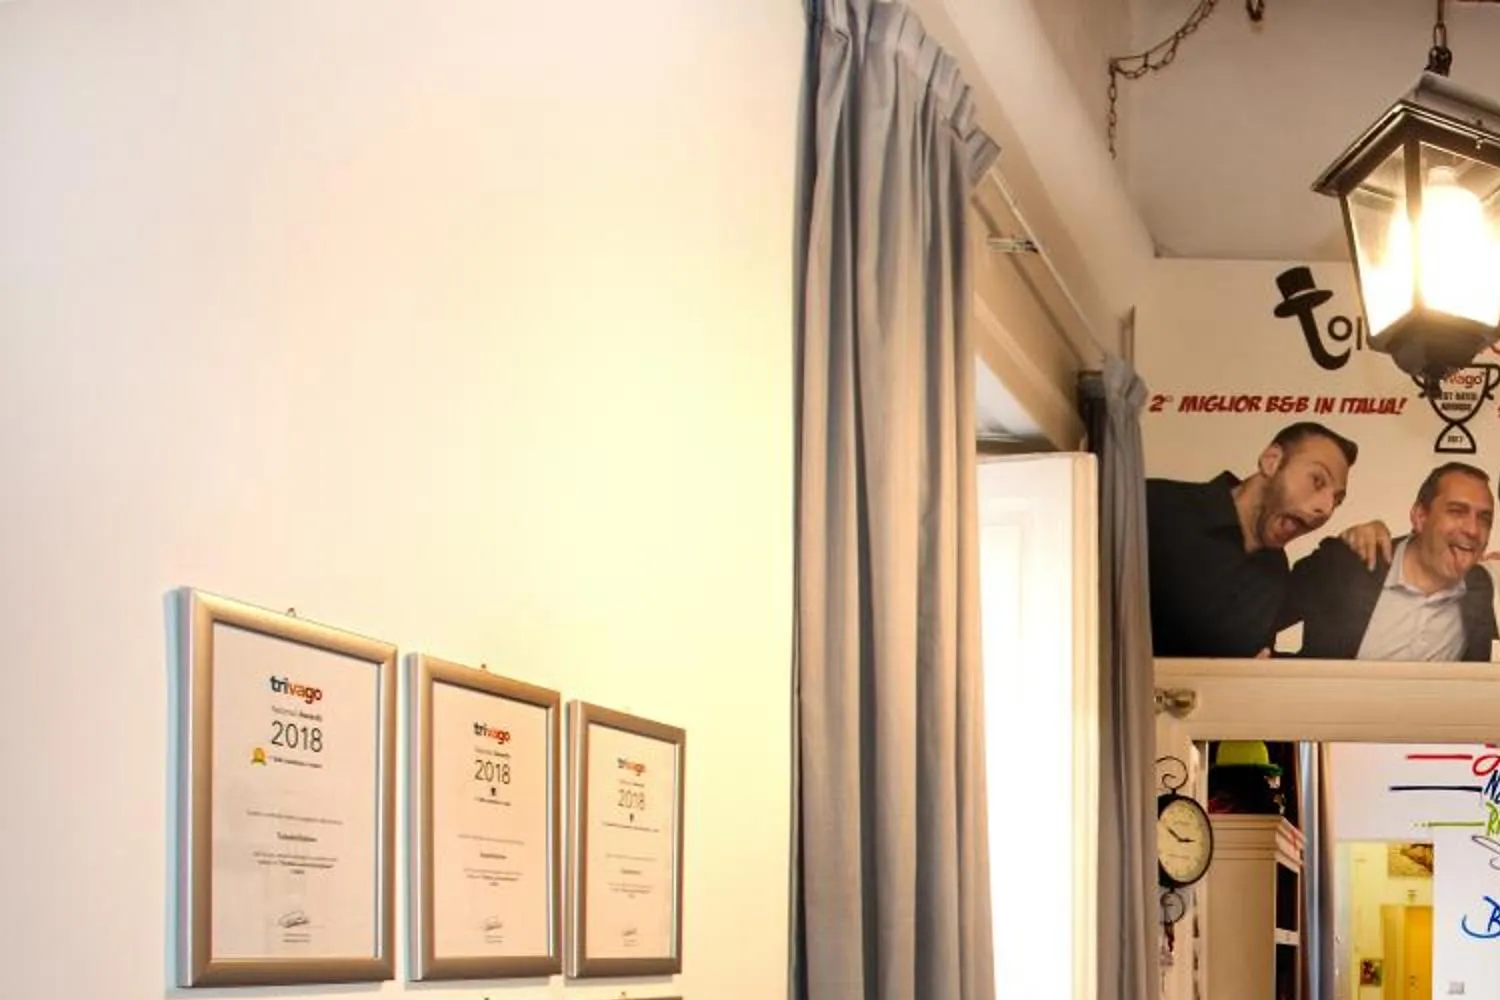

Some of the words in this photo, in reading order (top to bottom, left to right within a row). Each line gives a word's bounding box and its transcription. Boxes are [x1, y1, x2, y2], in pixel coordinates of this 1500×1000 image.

[1178, 395, 1263, 414] MIGLIOR
[1265, 396, 1310, 414] B&B
[1313, 397, 1336, 415] IN
[1339, 397, 1408, 416] ITALIA!
[270, 675, 323, 705] trivago
[271, 719, 324, 753] 2018
[473, 721, 511, 745] trivago
[474, 759, 511, 785] 2018
